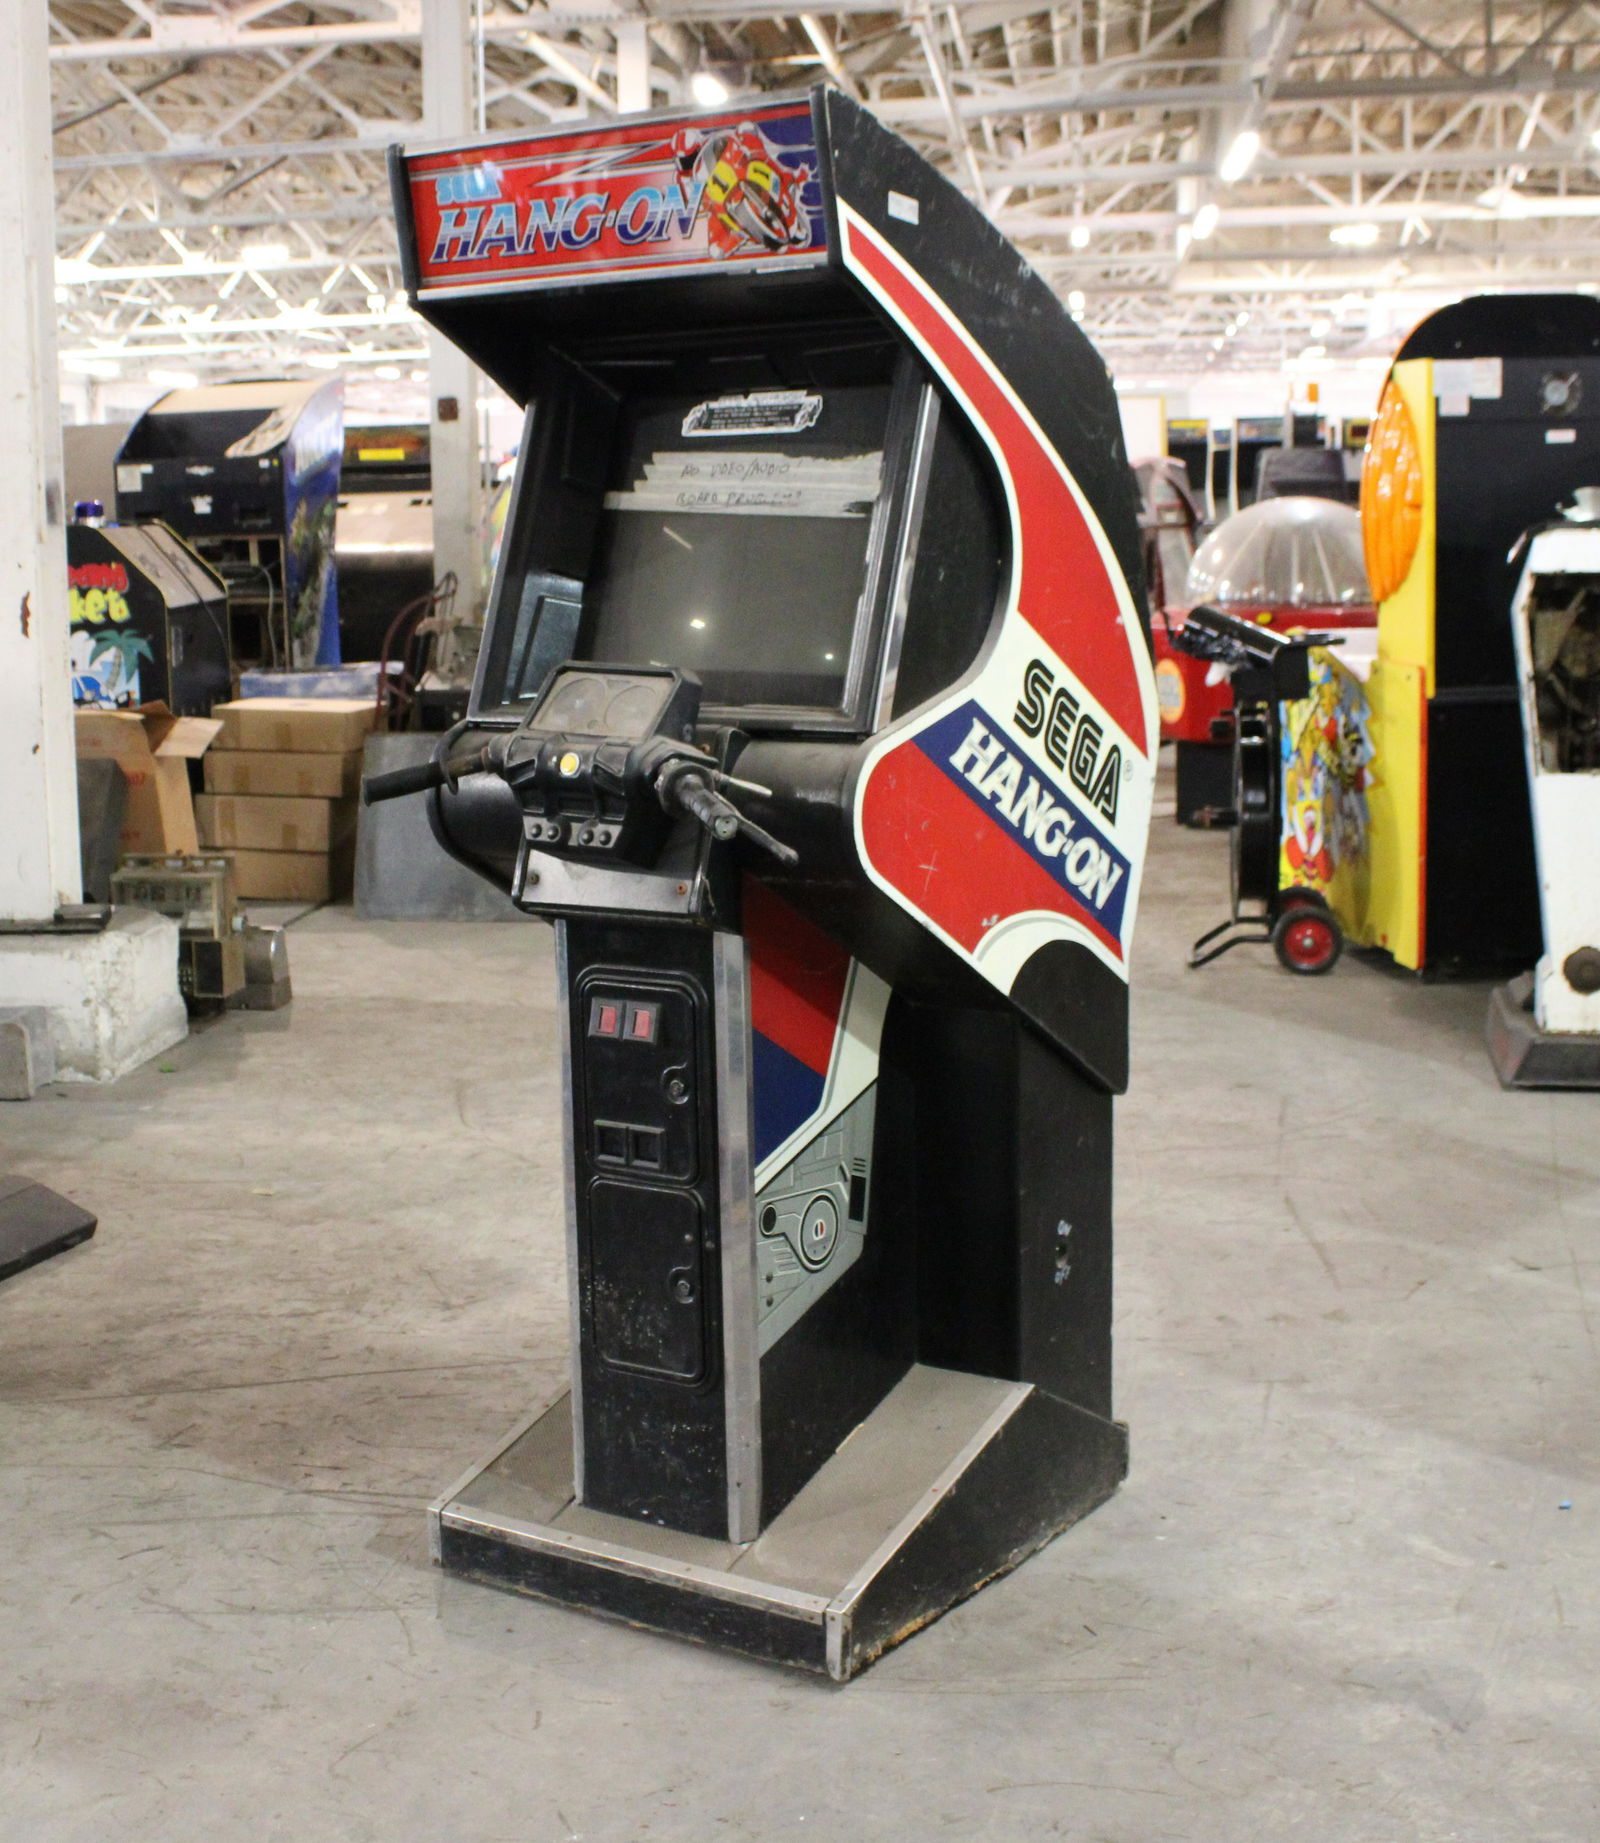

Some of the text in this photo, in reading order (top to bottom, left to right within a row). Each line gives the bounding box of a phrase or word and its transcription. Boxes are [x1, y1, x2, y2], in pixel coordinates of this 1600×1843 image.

[429, 183, 705, 264] HANG-ON
[948, 716, 1124, 911] HANG-ON
[1013, 658, 1122, 828] SEGA
